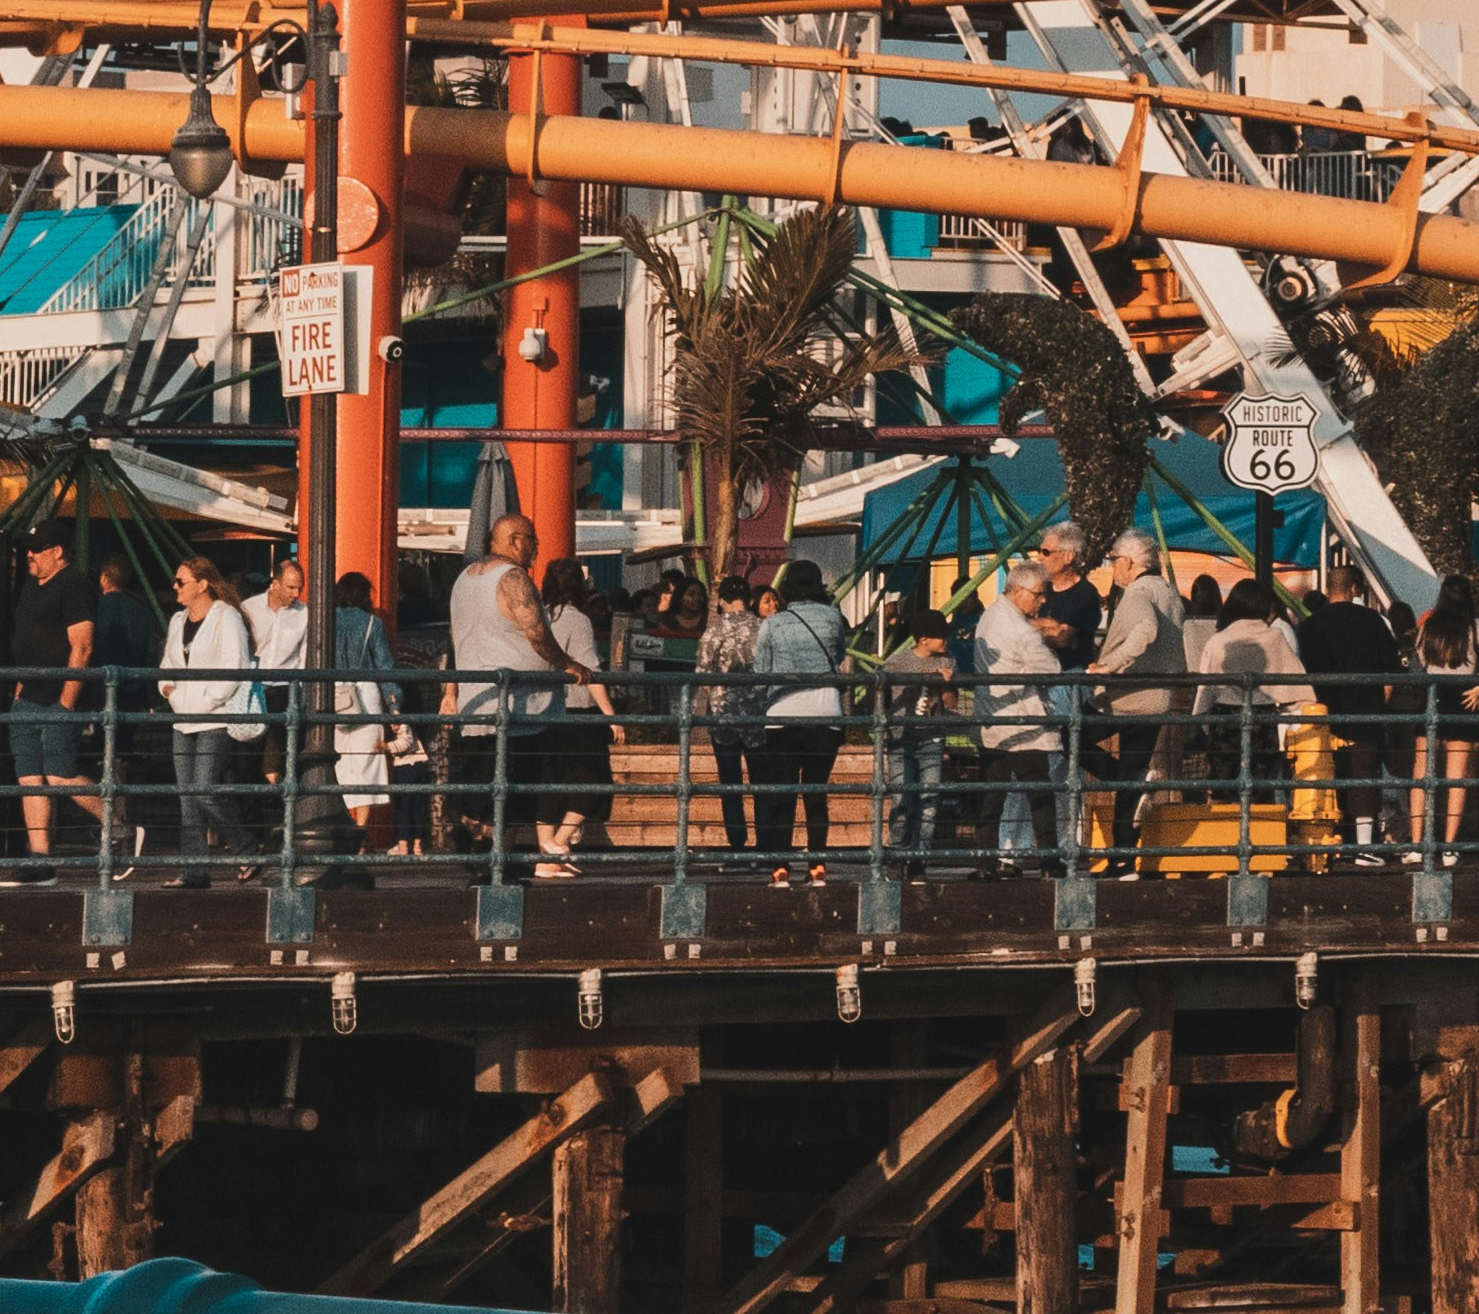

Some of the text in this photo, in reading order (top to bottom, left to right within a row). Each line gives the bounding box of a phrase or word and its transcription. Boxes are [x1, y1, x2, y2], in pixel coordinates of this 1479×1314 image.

[284, 271, 339, 295] NO PARKING
[286, 296, 337, 313] AT ANY TIME
[292, 322, 332, 352] FIRE
[288, 355, 337, 387] LANE
[1243, 405, 1303, 423] HISTORIC
[1252, 429, 1294, 447] ROUTE
[1249, 448, 1296, 481] 66
